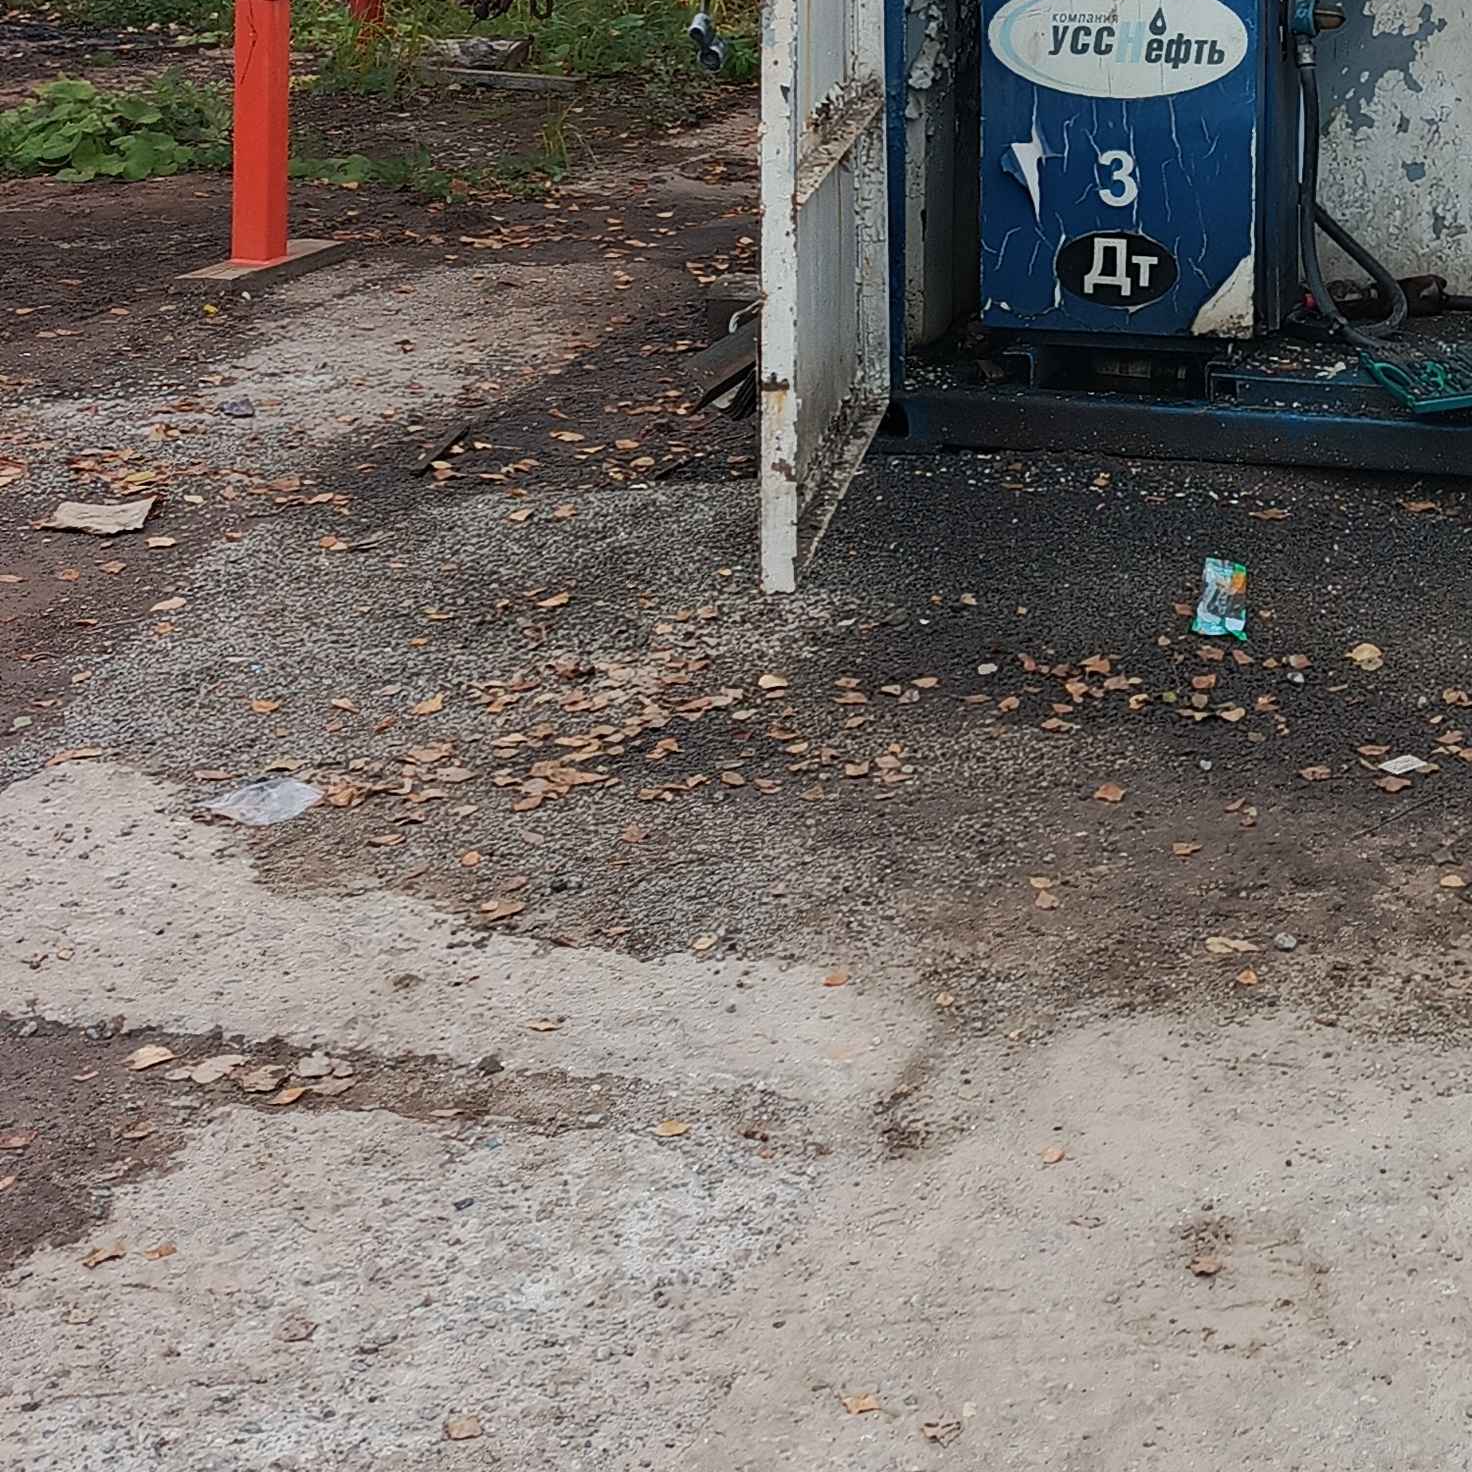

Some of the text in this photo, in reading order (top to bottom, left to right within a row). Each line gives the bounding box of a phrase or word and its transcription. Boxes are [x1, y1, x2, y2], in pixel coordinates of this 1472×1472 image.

[1052, 12, 1118, 24] компания
[1099, 149, 1138, 207] 3
[1083, 237, 1158, 297] Дт
